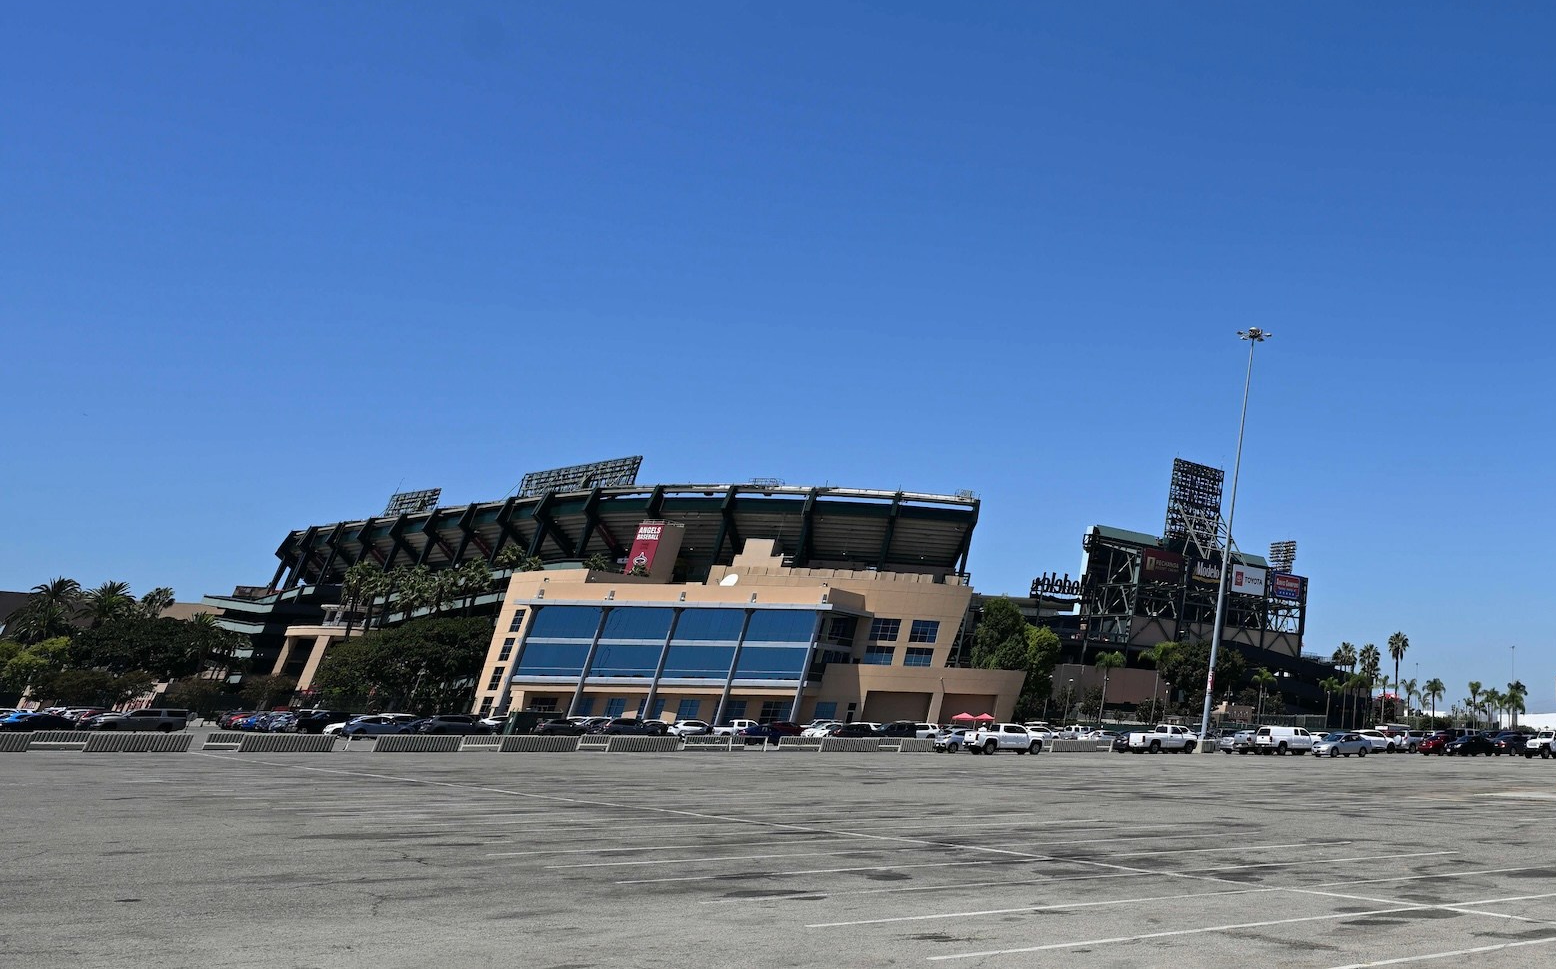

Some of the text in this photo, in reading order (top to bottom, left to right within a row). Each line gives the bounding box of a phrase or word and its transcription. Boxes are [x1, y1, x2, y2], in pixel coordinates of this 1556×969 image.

[638, 526, 662, 534] ANGELS
[1196, 561, 1220, 580] Modelo
[1245, 577, 1263, 585] TOYOTA
